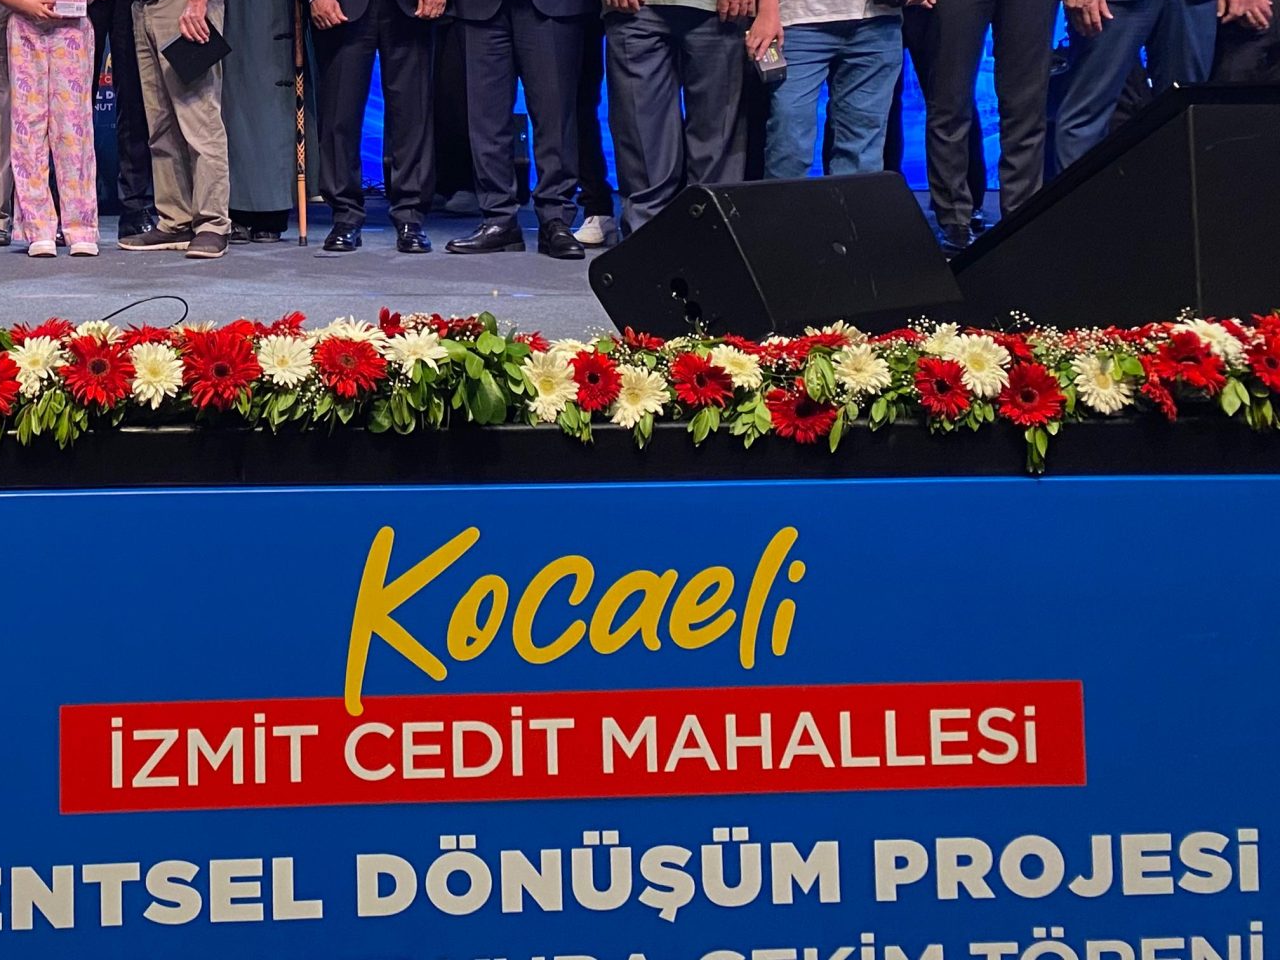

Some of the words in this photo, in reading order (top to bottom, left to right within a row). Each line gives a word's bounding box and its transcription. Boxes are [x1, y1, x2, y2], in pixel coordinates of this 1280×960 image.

[345, 525, 807, 714] Kocaeli
[112, 713, 318, 788] İZMİT
[342, 705, 567, 782] CEDİT
[357, 827, 840, 922] DÖNÜŞÜM
